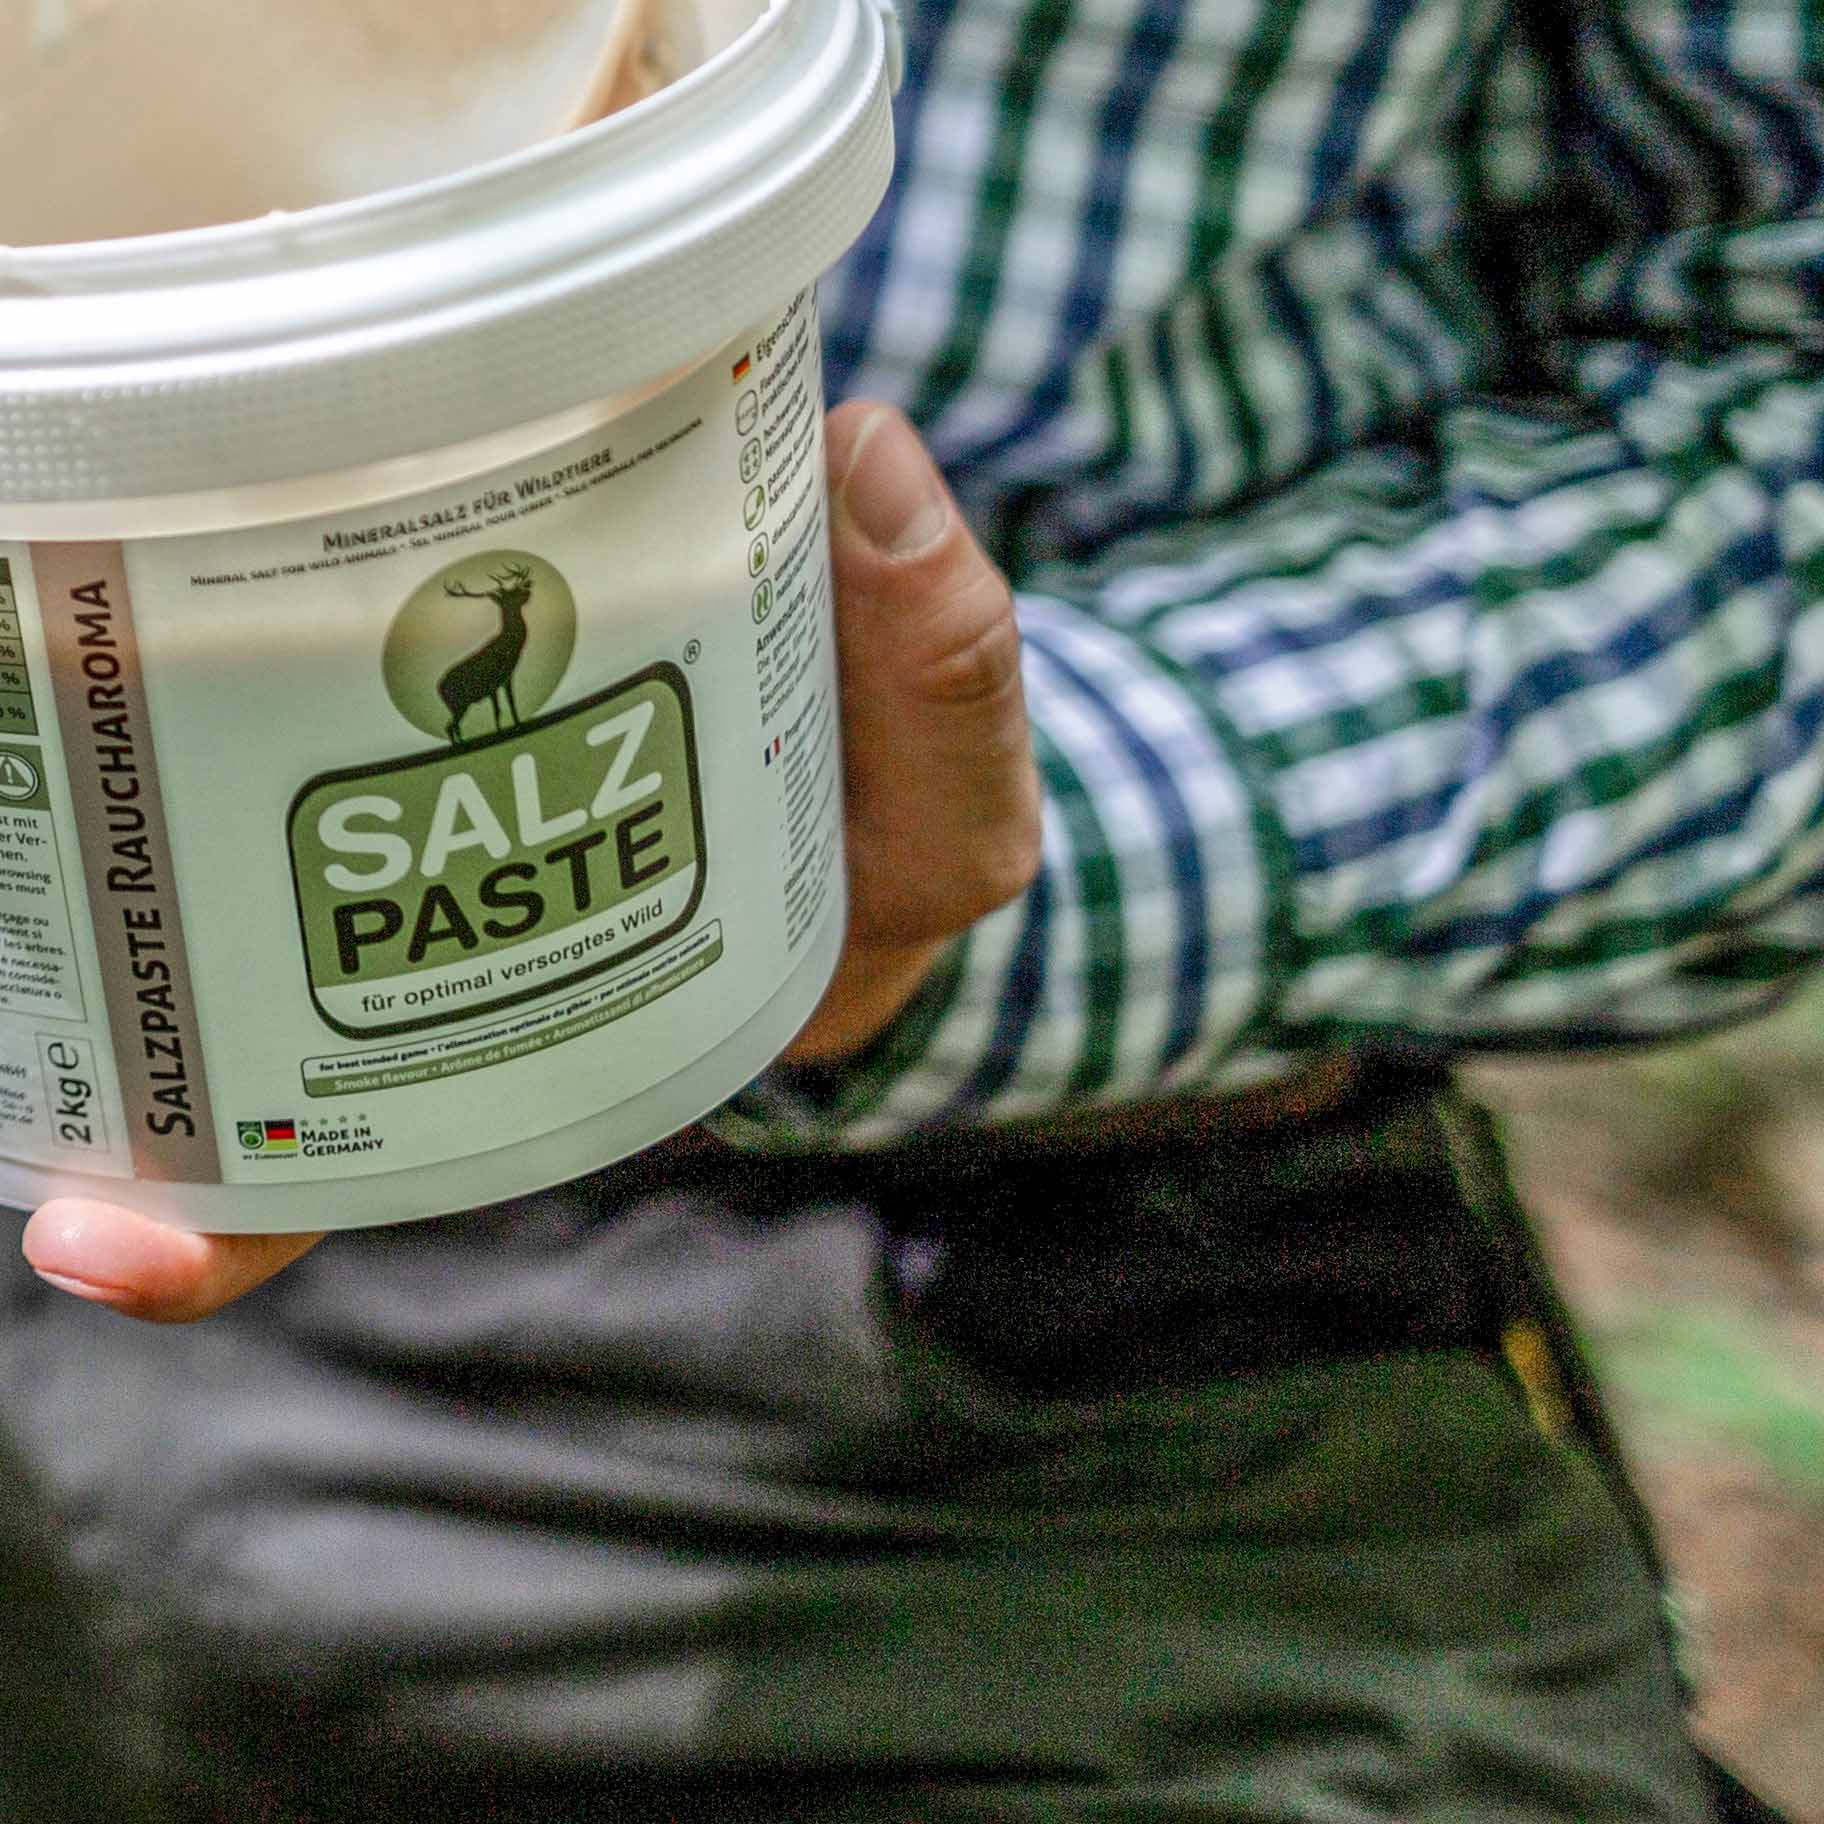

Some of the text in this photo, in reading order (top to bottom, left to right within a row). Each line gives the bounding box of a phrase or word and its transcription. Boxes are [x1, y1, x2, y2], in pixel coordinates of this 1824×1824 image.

[0, 671, 21, 685] %
[7, 705, 27, 720] %
[317, 700, 664, 894] SALZ
[12, 816, 39, 830] mit
[15, 830, 48, 847] Ver-
[70, 578, 196, 1143] SALZPASTE RAUCHAROMA
[15, 883, 47, 896] must
[332, 799, 671, 976] PASTE
[33, 917, 50, 927] ou
[361, 994, 396, 1013] für
[404, 969, 493, 1006] optimal
[501, 927, 616, 980] versorgtes
[620, 900, 664, 934] Wild
[319, 1062, 335, 1073] for
[334, 1075, 379, 1092] Smoke
[381, 1066, 429, 1084] flavour
[485, 1049, 501, 1063] de
[56, 1076, 93, 1119] kg
[59, 1123, 92, 1145] 2
[301, 1125, 371, 1144] MADE IN
[302, 1138, 384, 1158] GERMANY
